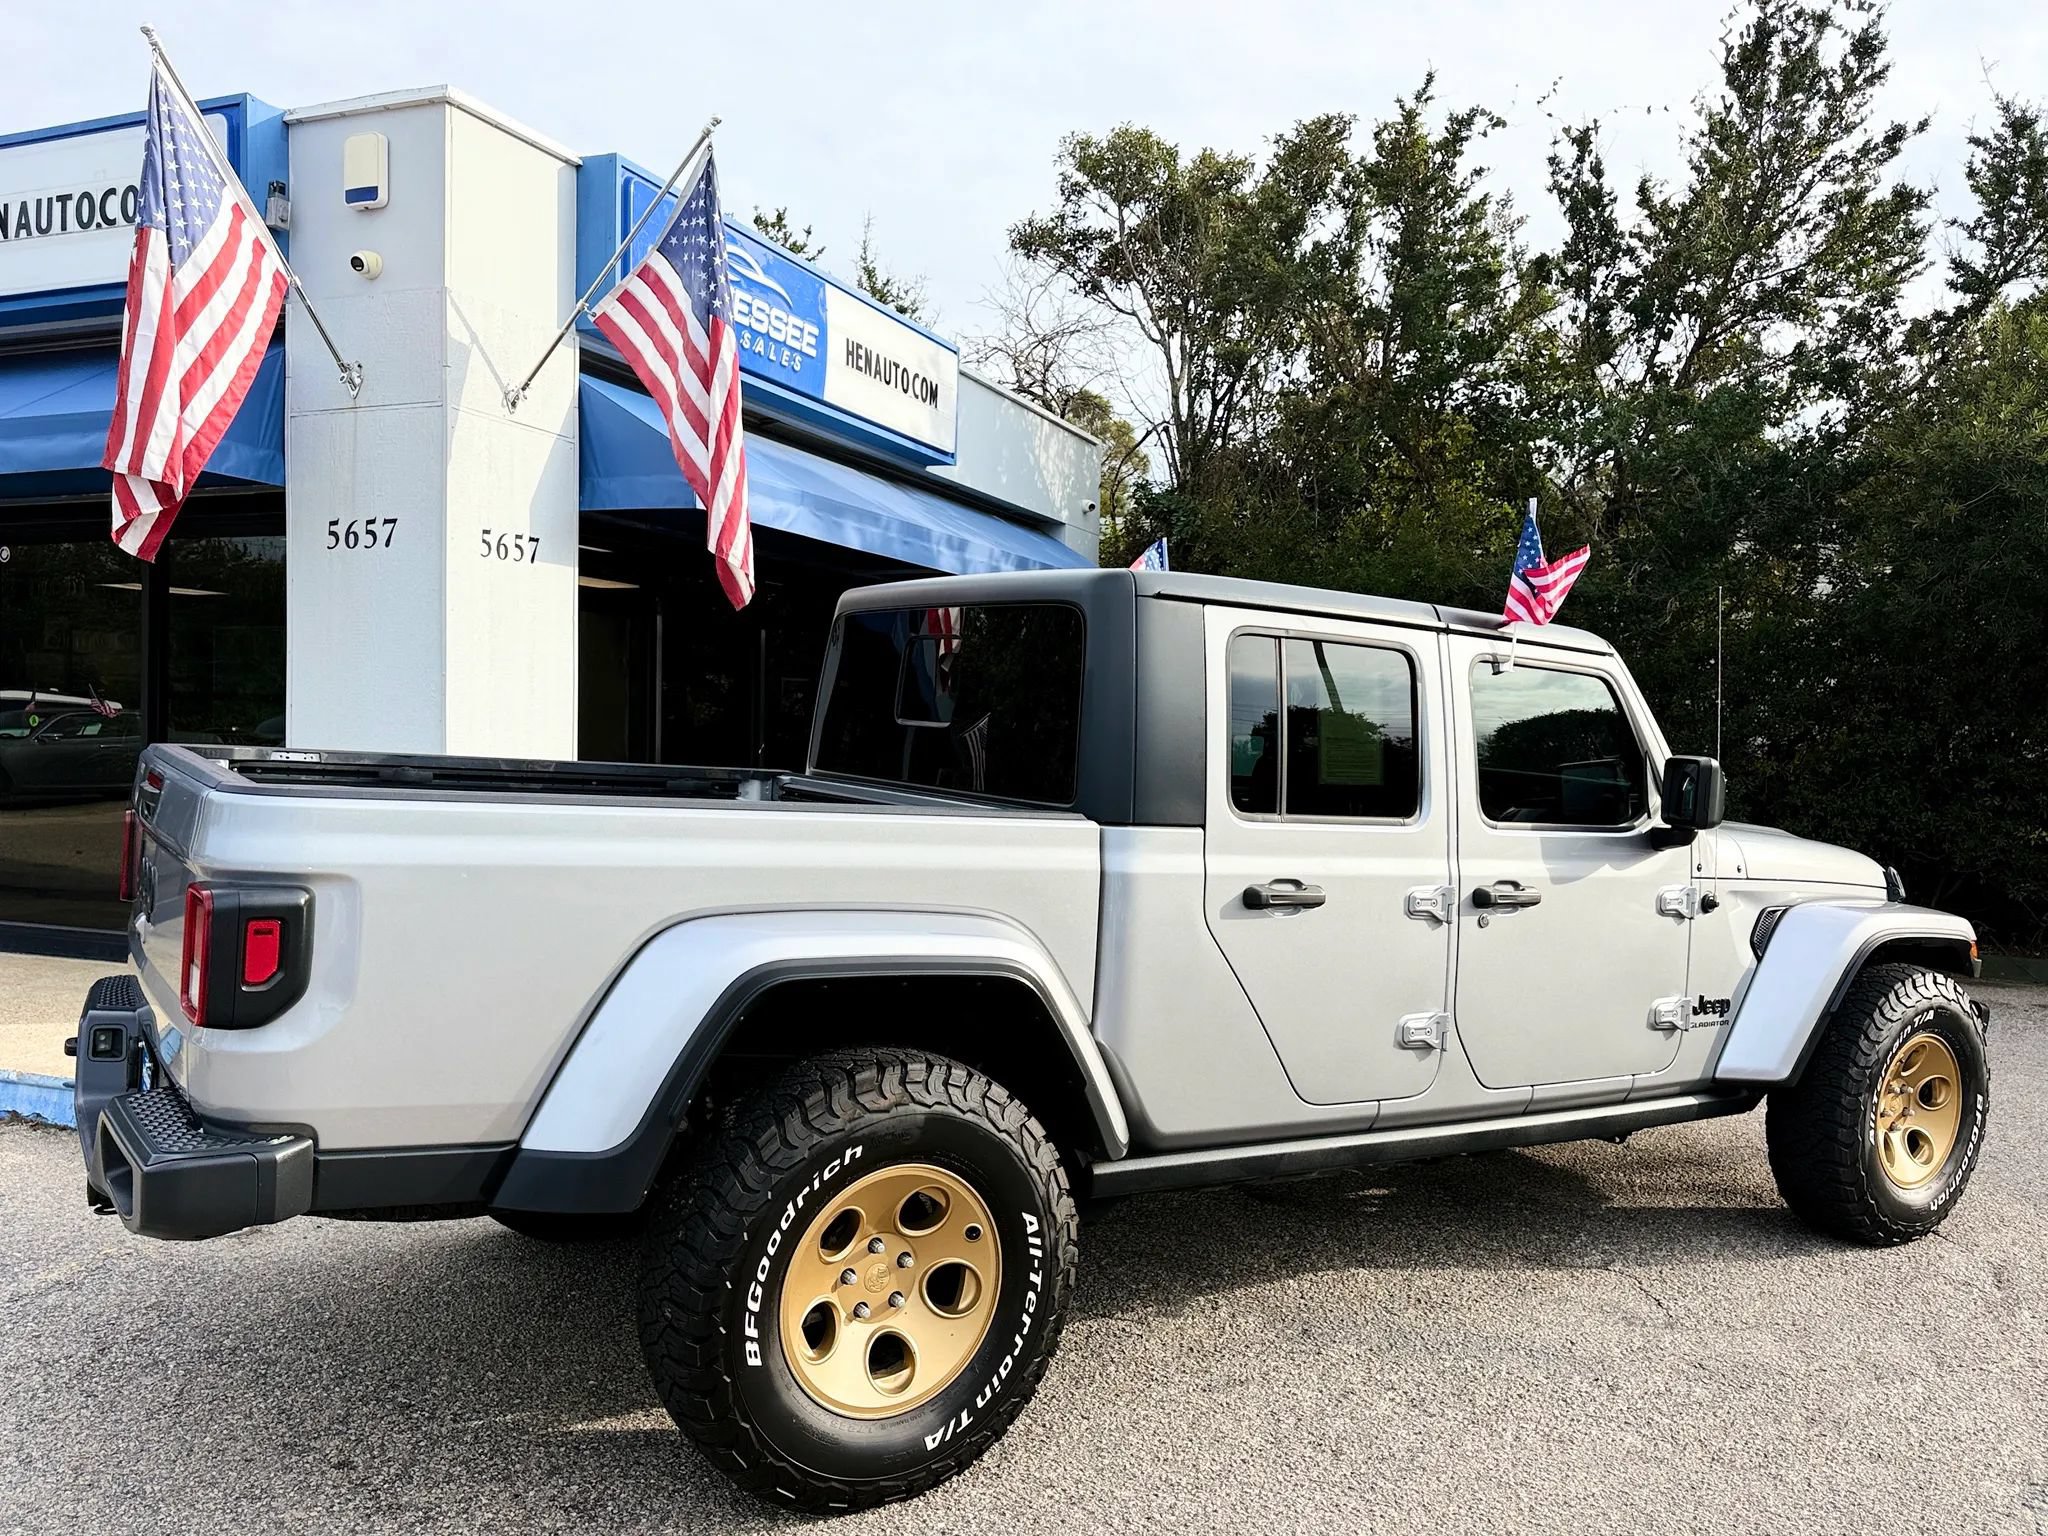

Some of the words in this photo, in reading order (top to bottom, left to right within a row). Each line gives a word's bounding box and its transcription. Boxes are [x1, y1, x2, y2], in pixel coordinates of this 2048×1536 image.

[740, 330, 802, 372] SALES
[326, 517, 398, 550] 5657
[480, 528, 540, 564] 5657
[1690, 1019, 1730, 1029] GLADIATOR
[1692, 994, 1731, 1018] Jeep
[1913, 1009, 1935, 1026] T/A
[1930, 1093, 1983, 1211] BFGoodrich
[744, 1144, 864, 1367] BFGoodrich
[976, 1211, 1044, 1409] All-Terrain
[924, 1407, 974, 1452] T/A
